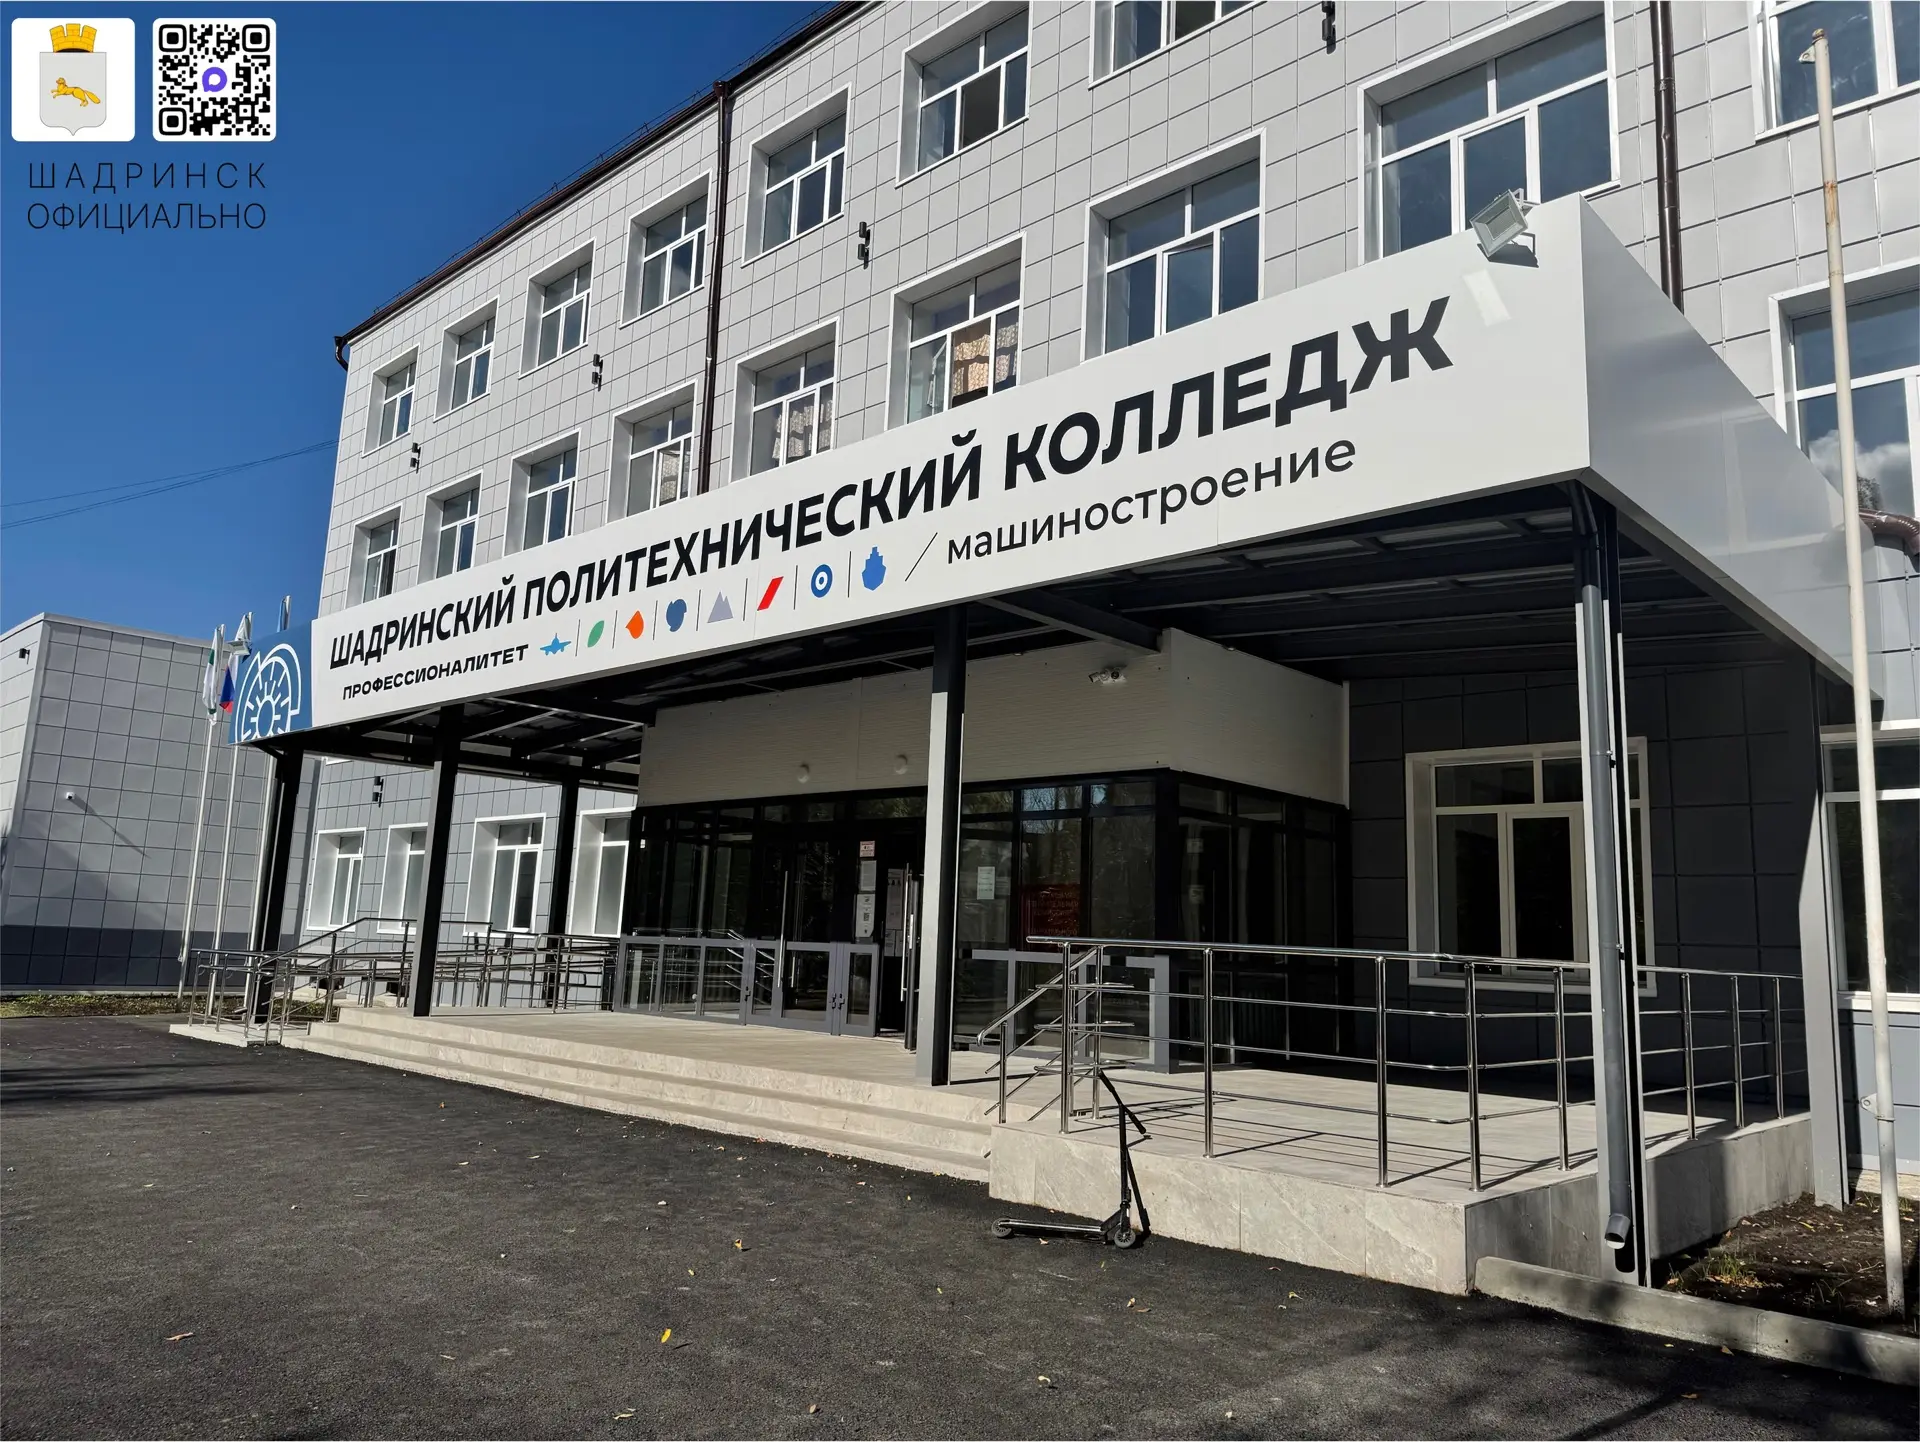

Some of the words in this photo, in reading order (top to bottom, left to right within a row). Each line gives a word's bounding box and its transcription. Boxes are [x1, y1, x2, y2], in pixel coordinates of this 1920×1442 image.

[329, 573, 517, 670] ШАДРИНСКИЙ
[522, 428, 982, 620] ПОЛИТЕХНИЧЕСКИЙ
[1004, 295, 1454, 491] КОЛЛЕДЖ
[947, 439, 1356, 565] машиностроение
[342, 643, 529, 700] ПРОФЕССИОНАЛИТЕТ
